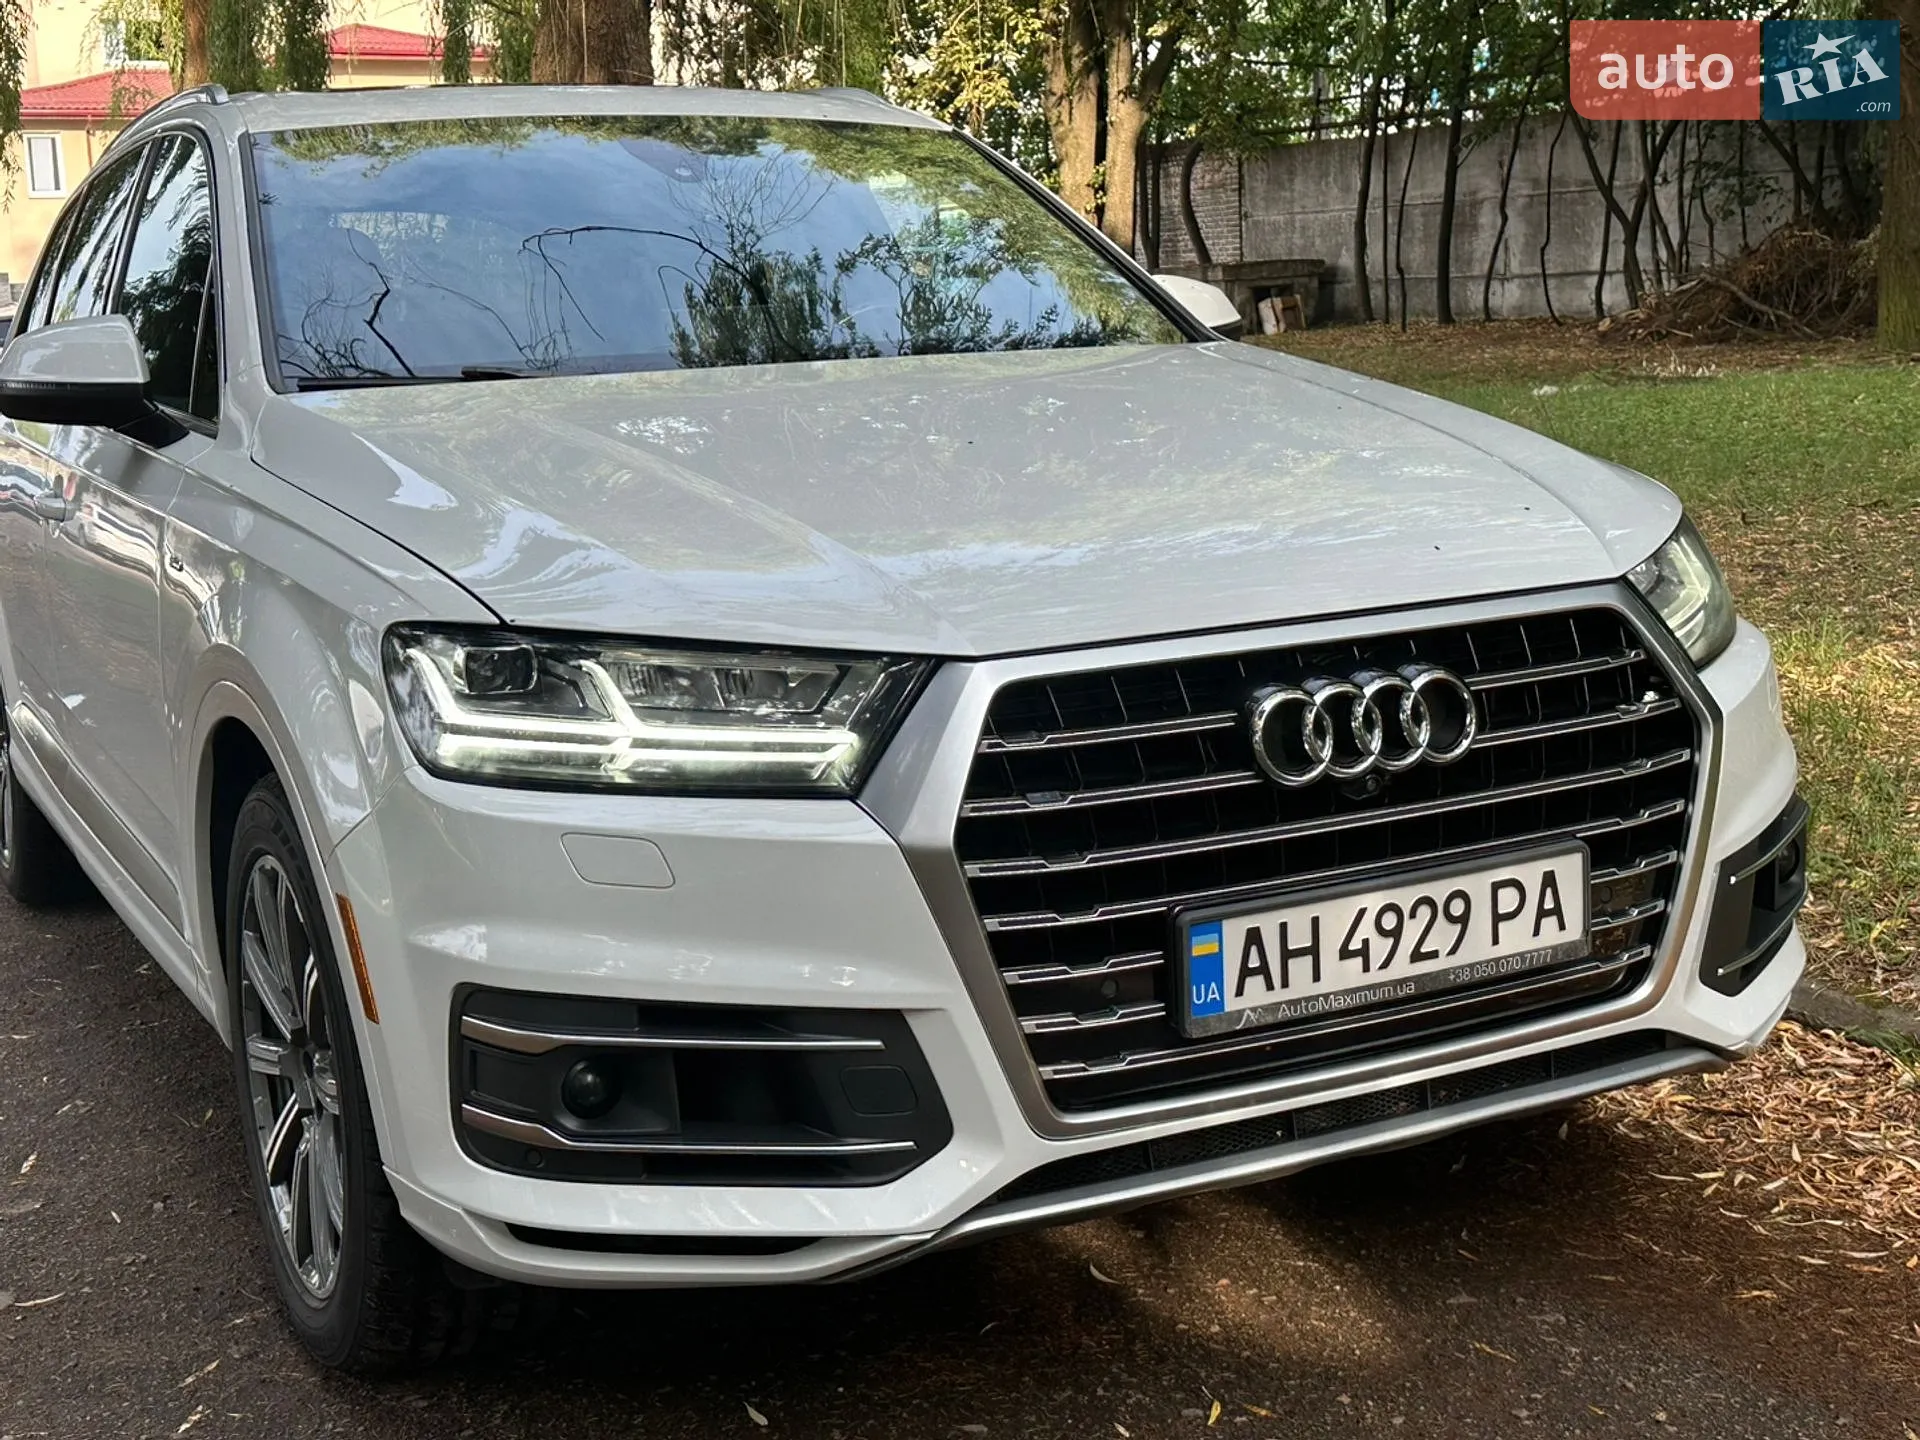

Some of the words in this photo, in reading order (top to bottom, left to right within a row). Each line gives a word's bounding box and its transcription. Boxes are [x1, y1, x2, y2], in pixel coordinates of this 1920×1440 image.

[1234, 914, 1321, 998] AH
[1338, 888, 1472, 973] 4929
[1490, 869, 1566, 946] PA
[1448, 966, 1471, 983] +38
[1474, 961, 1496, 978] 050
[1193, 981, 1221, 1004] UA
